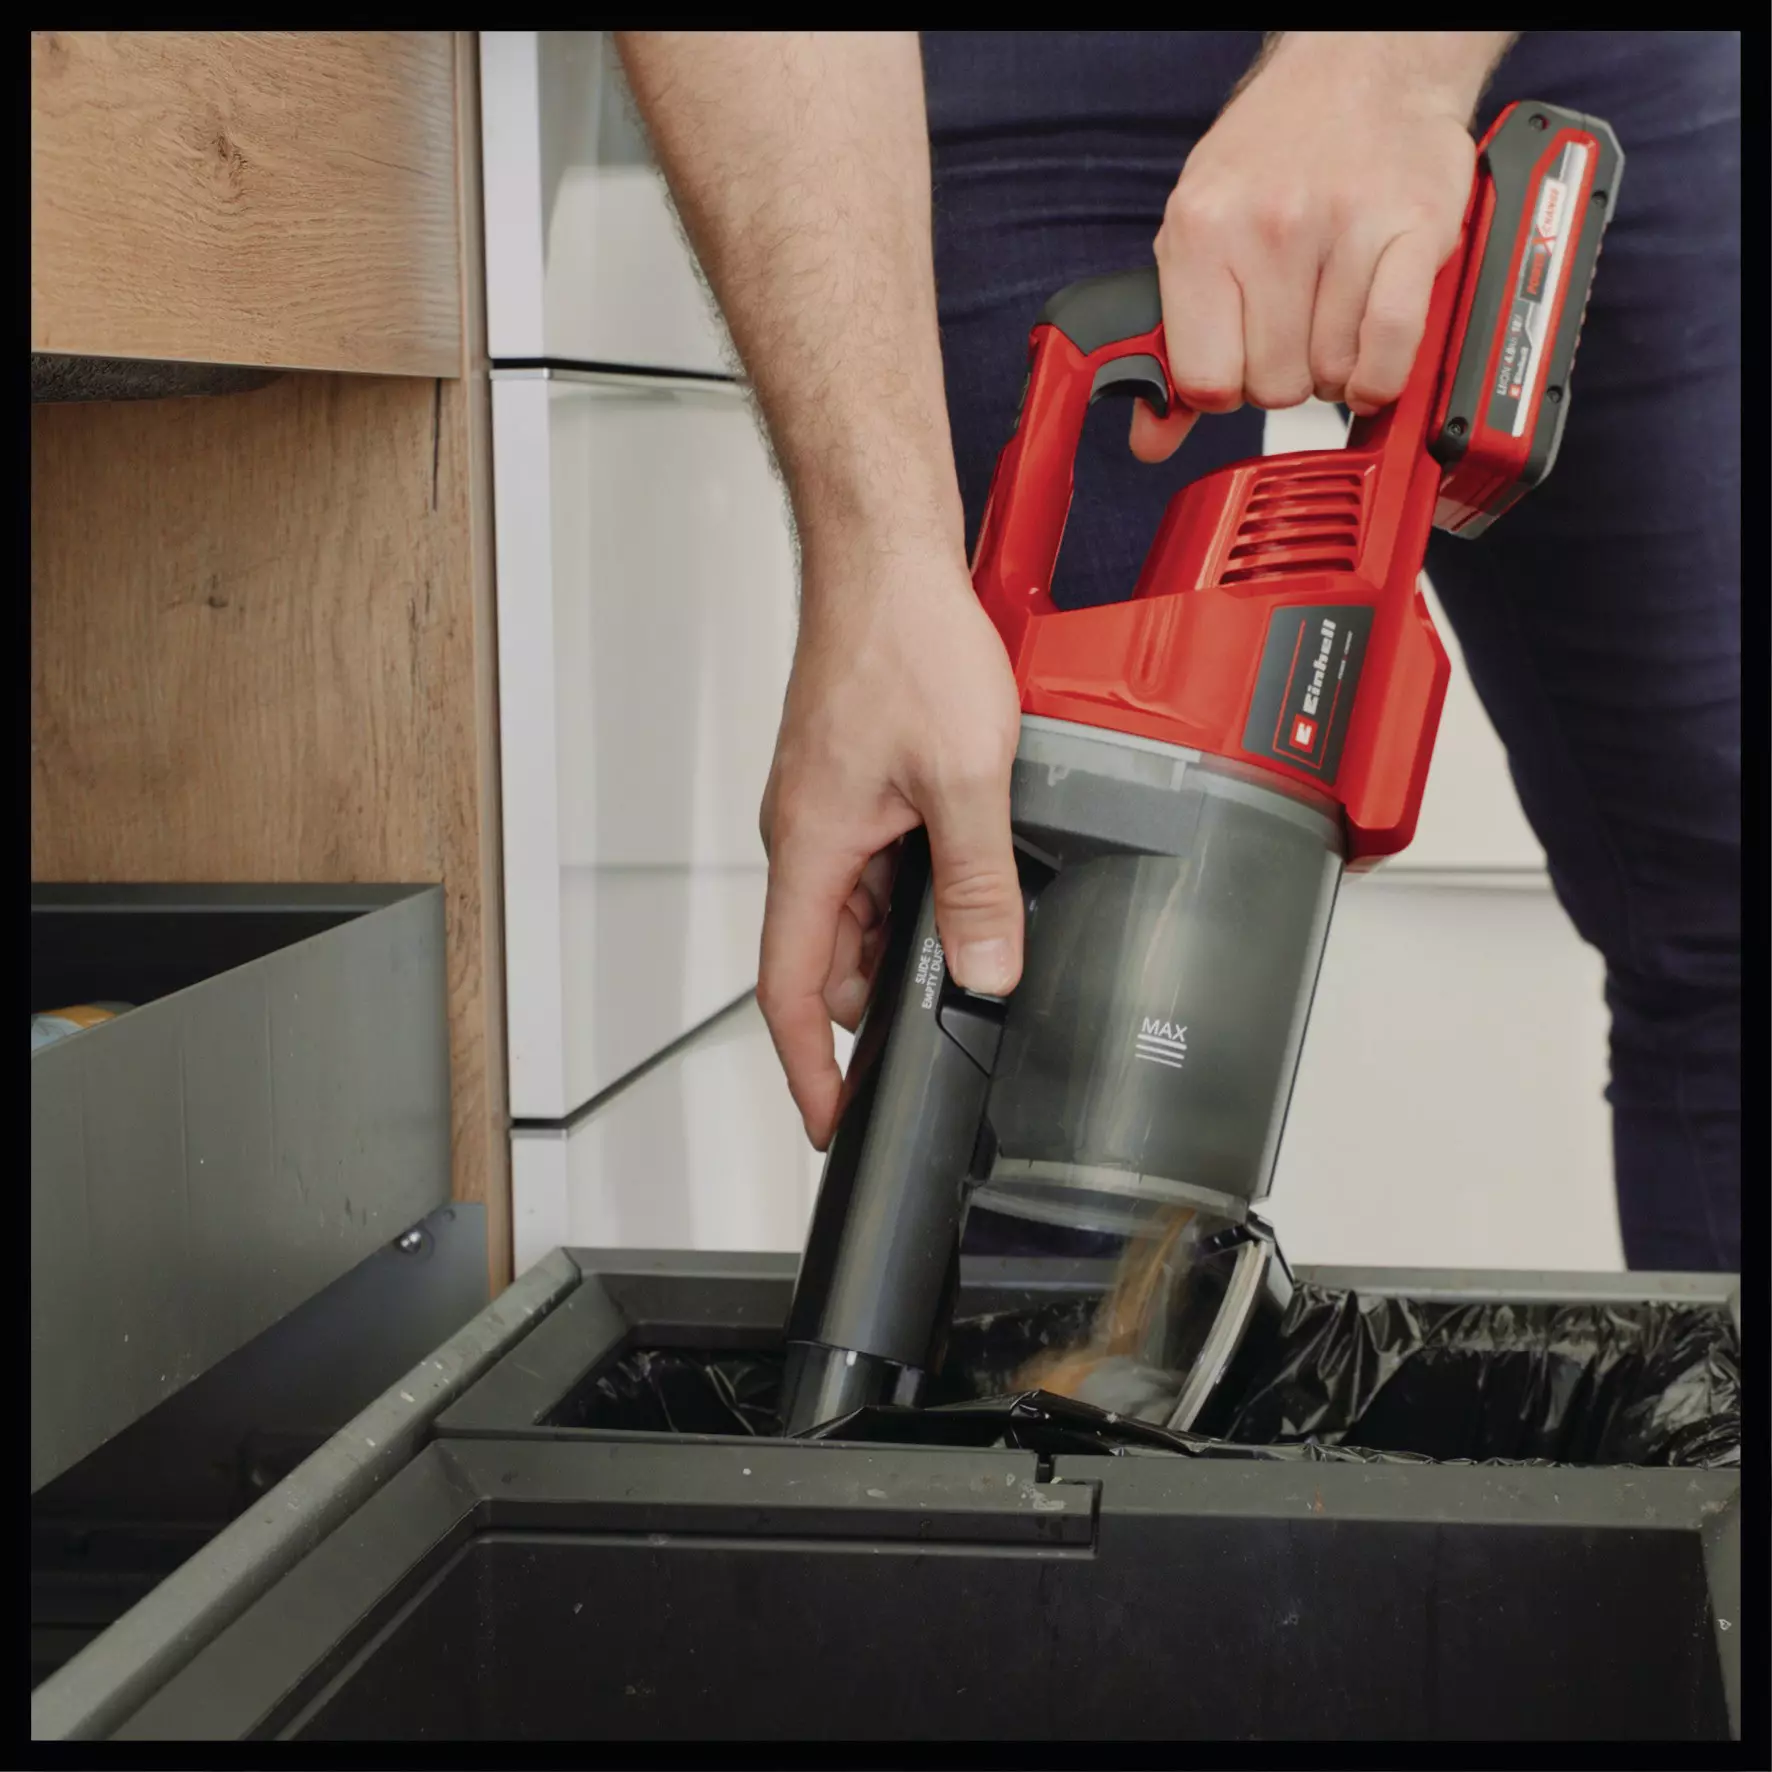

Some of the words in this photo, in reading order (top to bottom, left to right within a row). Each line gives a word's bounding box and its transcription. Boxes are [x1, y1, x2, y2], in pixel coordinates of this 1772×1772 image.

[1302, 618, 1336, 715] Einhell
[915, 955, 931, 984] SLIDE
[923, 937, 935, 953] TO
[921, 973, 938, 1009] EMPTY
[1141, 1016, 1188, 1042] MAX
